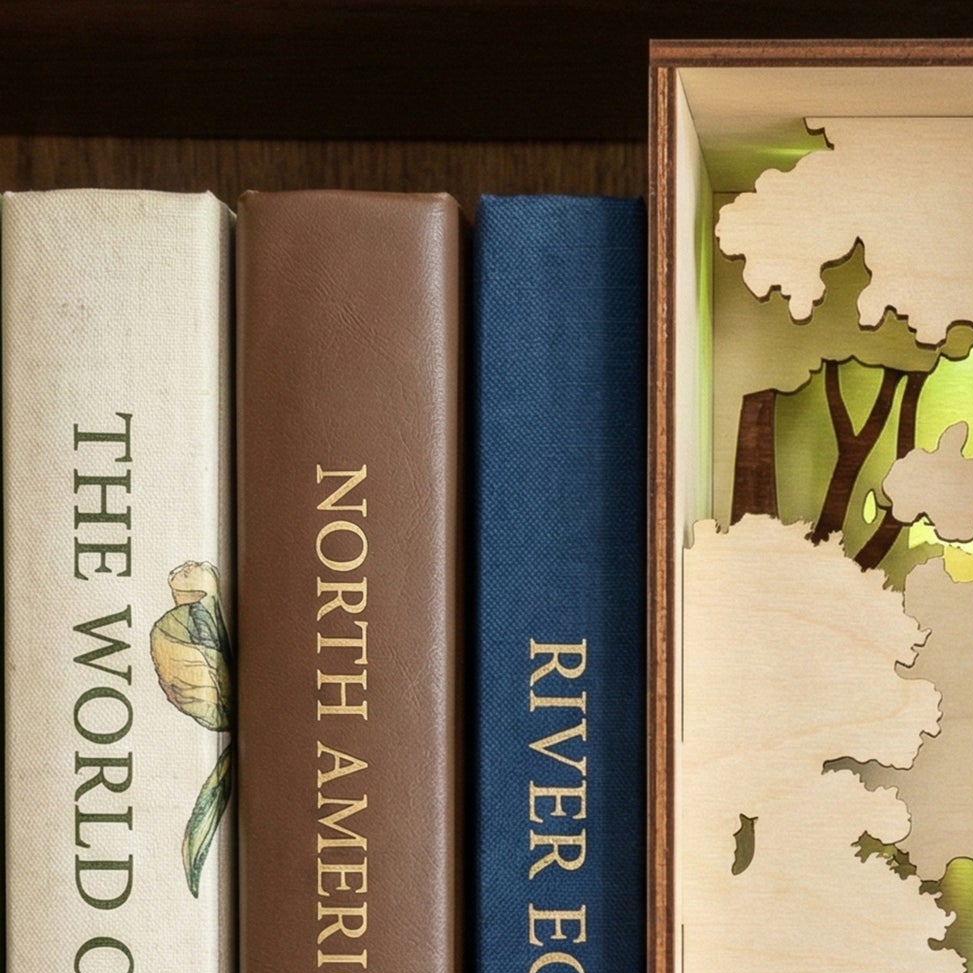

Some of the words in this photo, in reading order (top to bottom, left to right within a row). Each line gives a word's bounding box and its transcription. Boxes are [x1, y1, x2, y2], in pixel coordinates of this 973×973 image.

[73, 411, 133, 581] THE
[315, 463, 369, 721] NORTH
[72, 604, 134, 911] WORLD
[528, 637, 587, 880] RIVER
